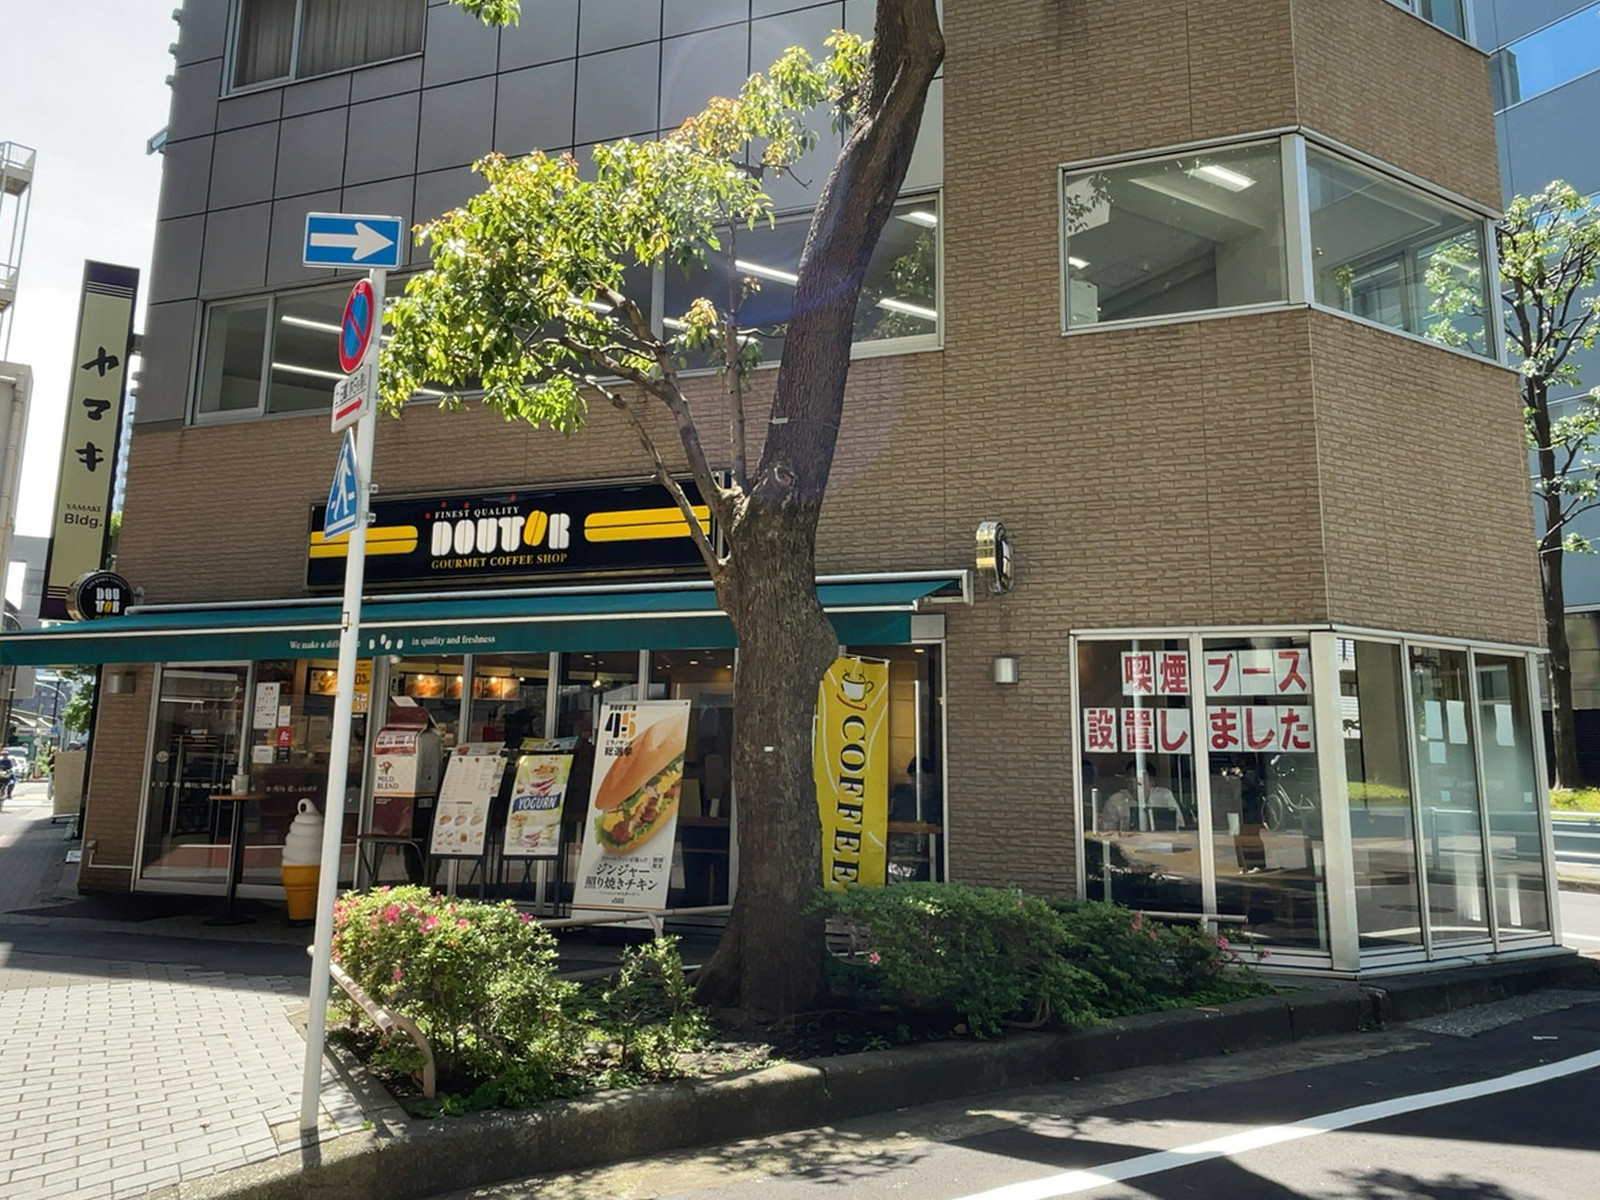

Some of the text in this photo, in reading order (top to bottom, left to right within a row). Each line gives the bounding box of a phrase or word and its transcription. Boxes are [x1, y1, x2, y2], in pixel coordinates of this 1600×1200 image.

[75, 346, 119, 472] ヤマキ
[66, 503, 101, 512] YAMAKI
[434, 506, 520, 519] FINEST QUALITY
[64, 513, 103, 529] Bldg.
[431, 510, 570, 556] DOUTOR
[431, 553, 567, 569] GOURMET COFFEE SHOP
[302, 641, 319, 649] make
[412, 637, 420, 645] in
[421, 636, 445, 647] quality
[446, 636, 461, 644] and
[462, 635, 496, 644] freshness
[1124, 650, 1308, 694] 喫煙ブース
[604, 712, 637, 739] 45
[1087, 707, 1312, 751] 設置しました
[376, 782, 400, 790] BLEND
[518, 797, 557, 809] YOGURN
[830, 714, 867, 885] COFFEE
[596, 863, 650, 877] ジンジャー
[584, 875, 658, 892] 照り焼きチキン
